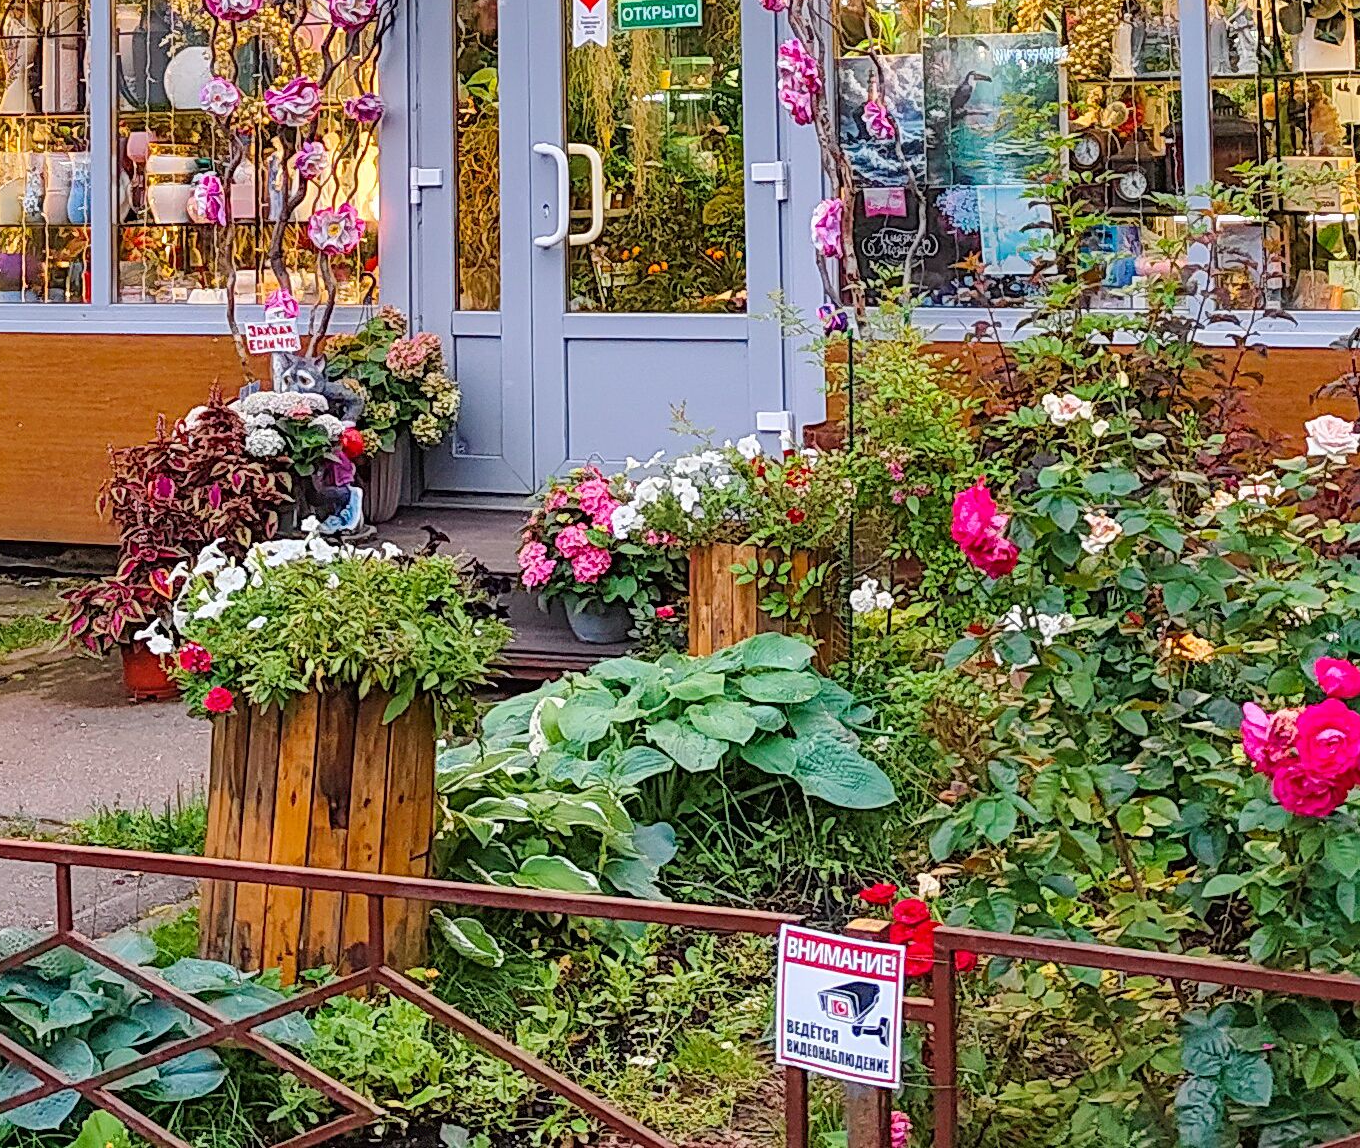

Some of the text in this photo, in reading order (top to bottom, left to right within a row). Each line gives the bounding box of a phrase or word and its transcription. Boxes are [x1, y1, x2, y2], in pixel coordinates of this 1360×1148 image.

[622, 3, 698, 23] ОТКРЫТО
[786, 935, 897, 978] ВНИМАНИЕ!
[786, 1018, 839, 1044] ВЕДЁТСЯ
[786, 1039, 890, 1074] ВИДЕОНАБЛЮДЕНИЕ
